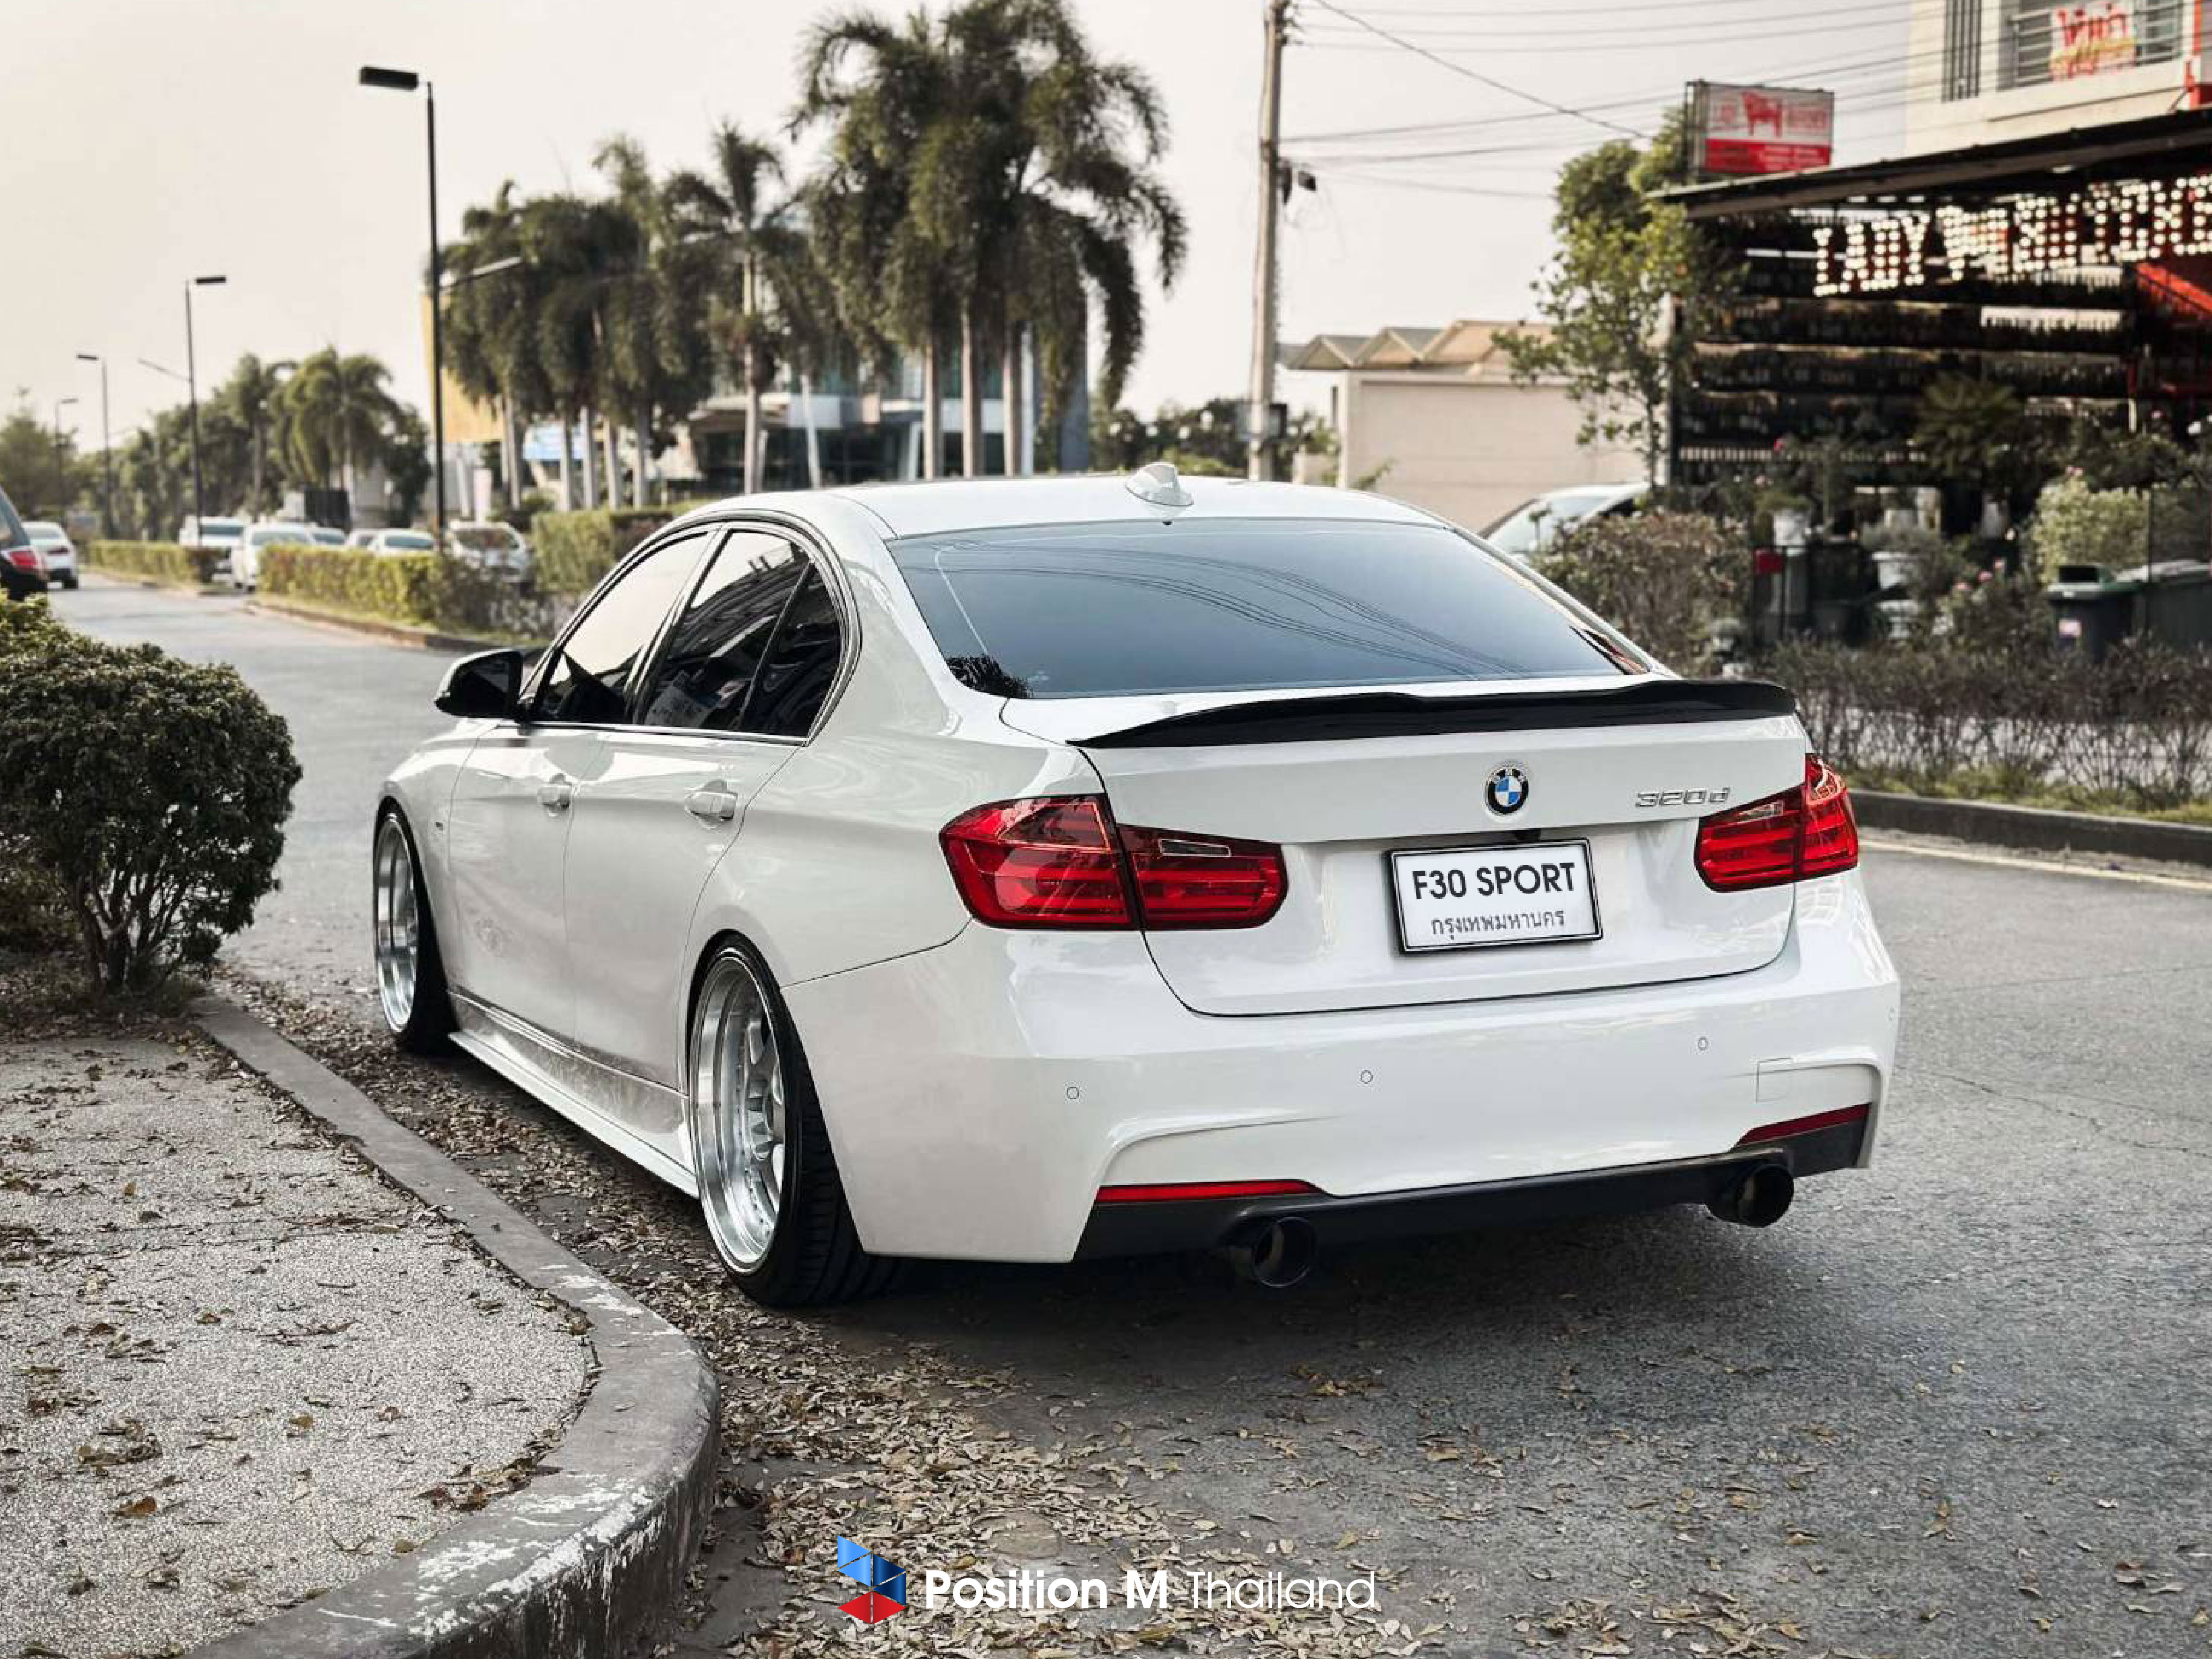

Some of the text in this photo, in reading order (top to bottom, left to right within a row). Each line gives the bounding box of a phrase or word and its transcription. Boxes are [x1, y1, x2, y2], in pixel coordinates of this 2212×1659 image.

[1812, 212, 1930, 297] LADY
[1635, 787, 1730, 807] 320d
[1412, 862, 1575, 899] F30 SPORT
[1431, 910, 1565, 940] กรุงเทพมหานคร
